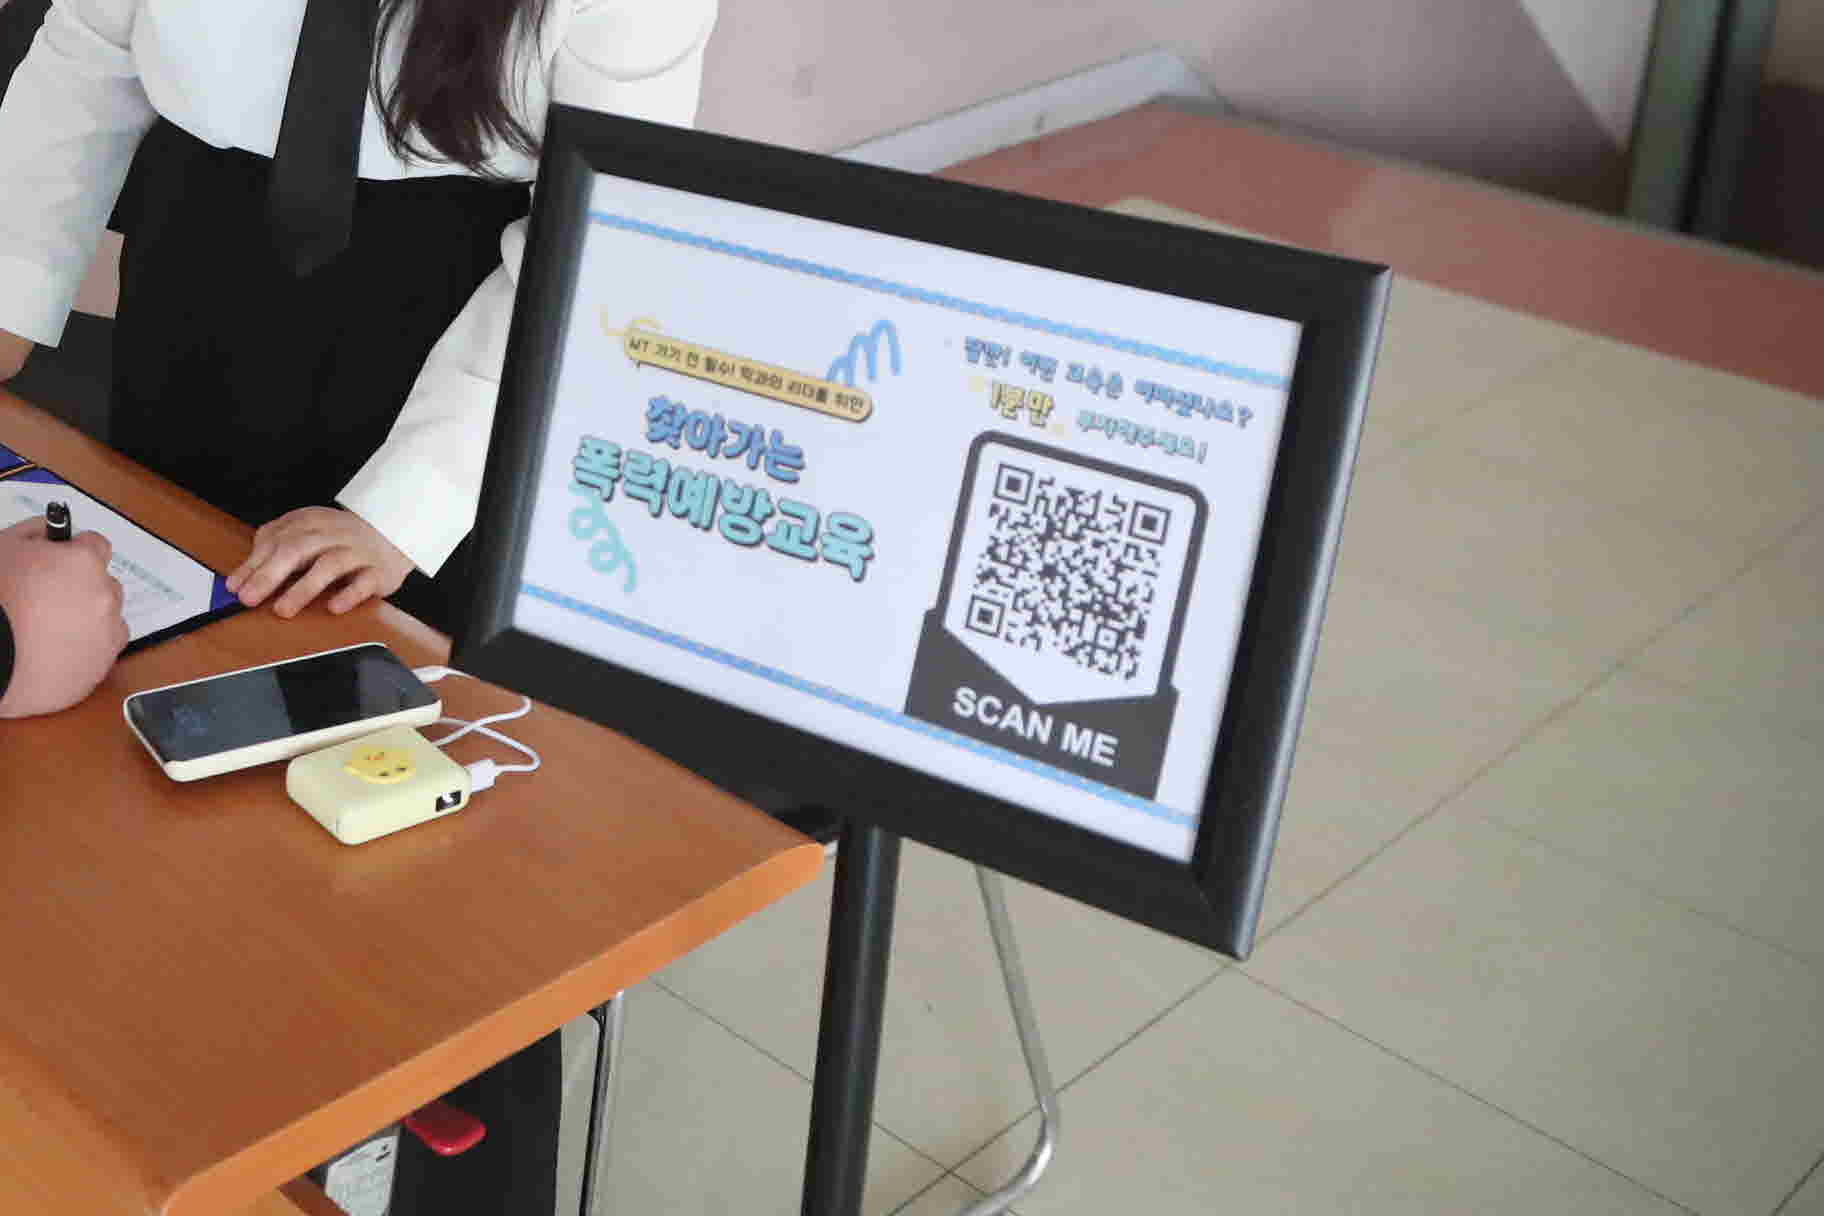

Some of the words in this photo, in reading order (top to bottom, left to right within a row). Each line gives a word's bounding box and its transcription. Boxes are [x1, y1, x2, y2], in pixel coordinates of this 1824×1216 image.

[628, 337, 649, 355] MT
[655, 343, 682, 364] 가기
[644, 394, 806, 484] 찾아가는
[990, 381, 1055, 429] 1분만
[573, 435, 875, 583] 폭력예방교육
[952, 686, 1054, 745] SCAN
[1060, 722, 1120, 769] ME
